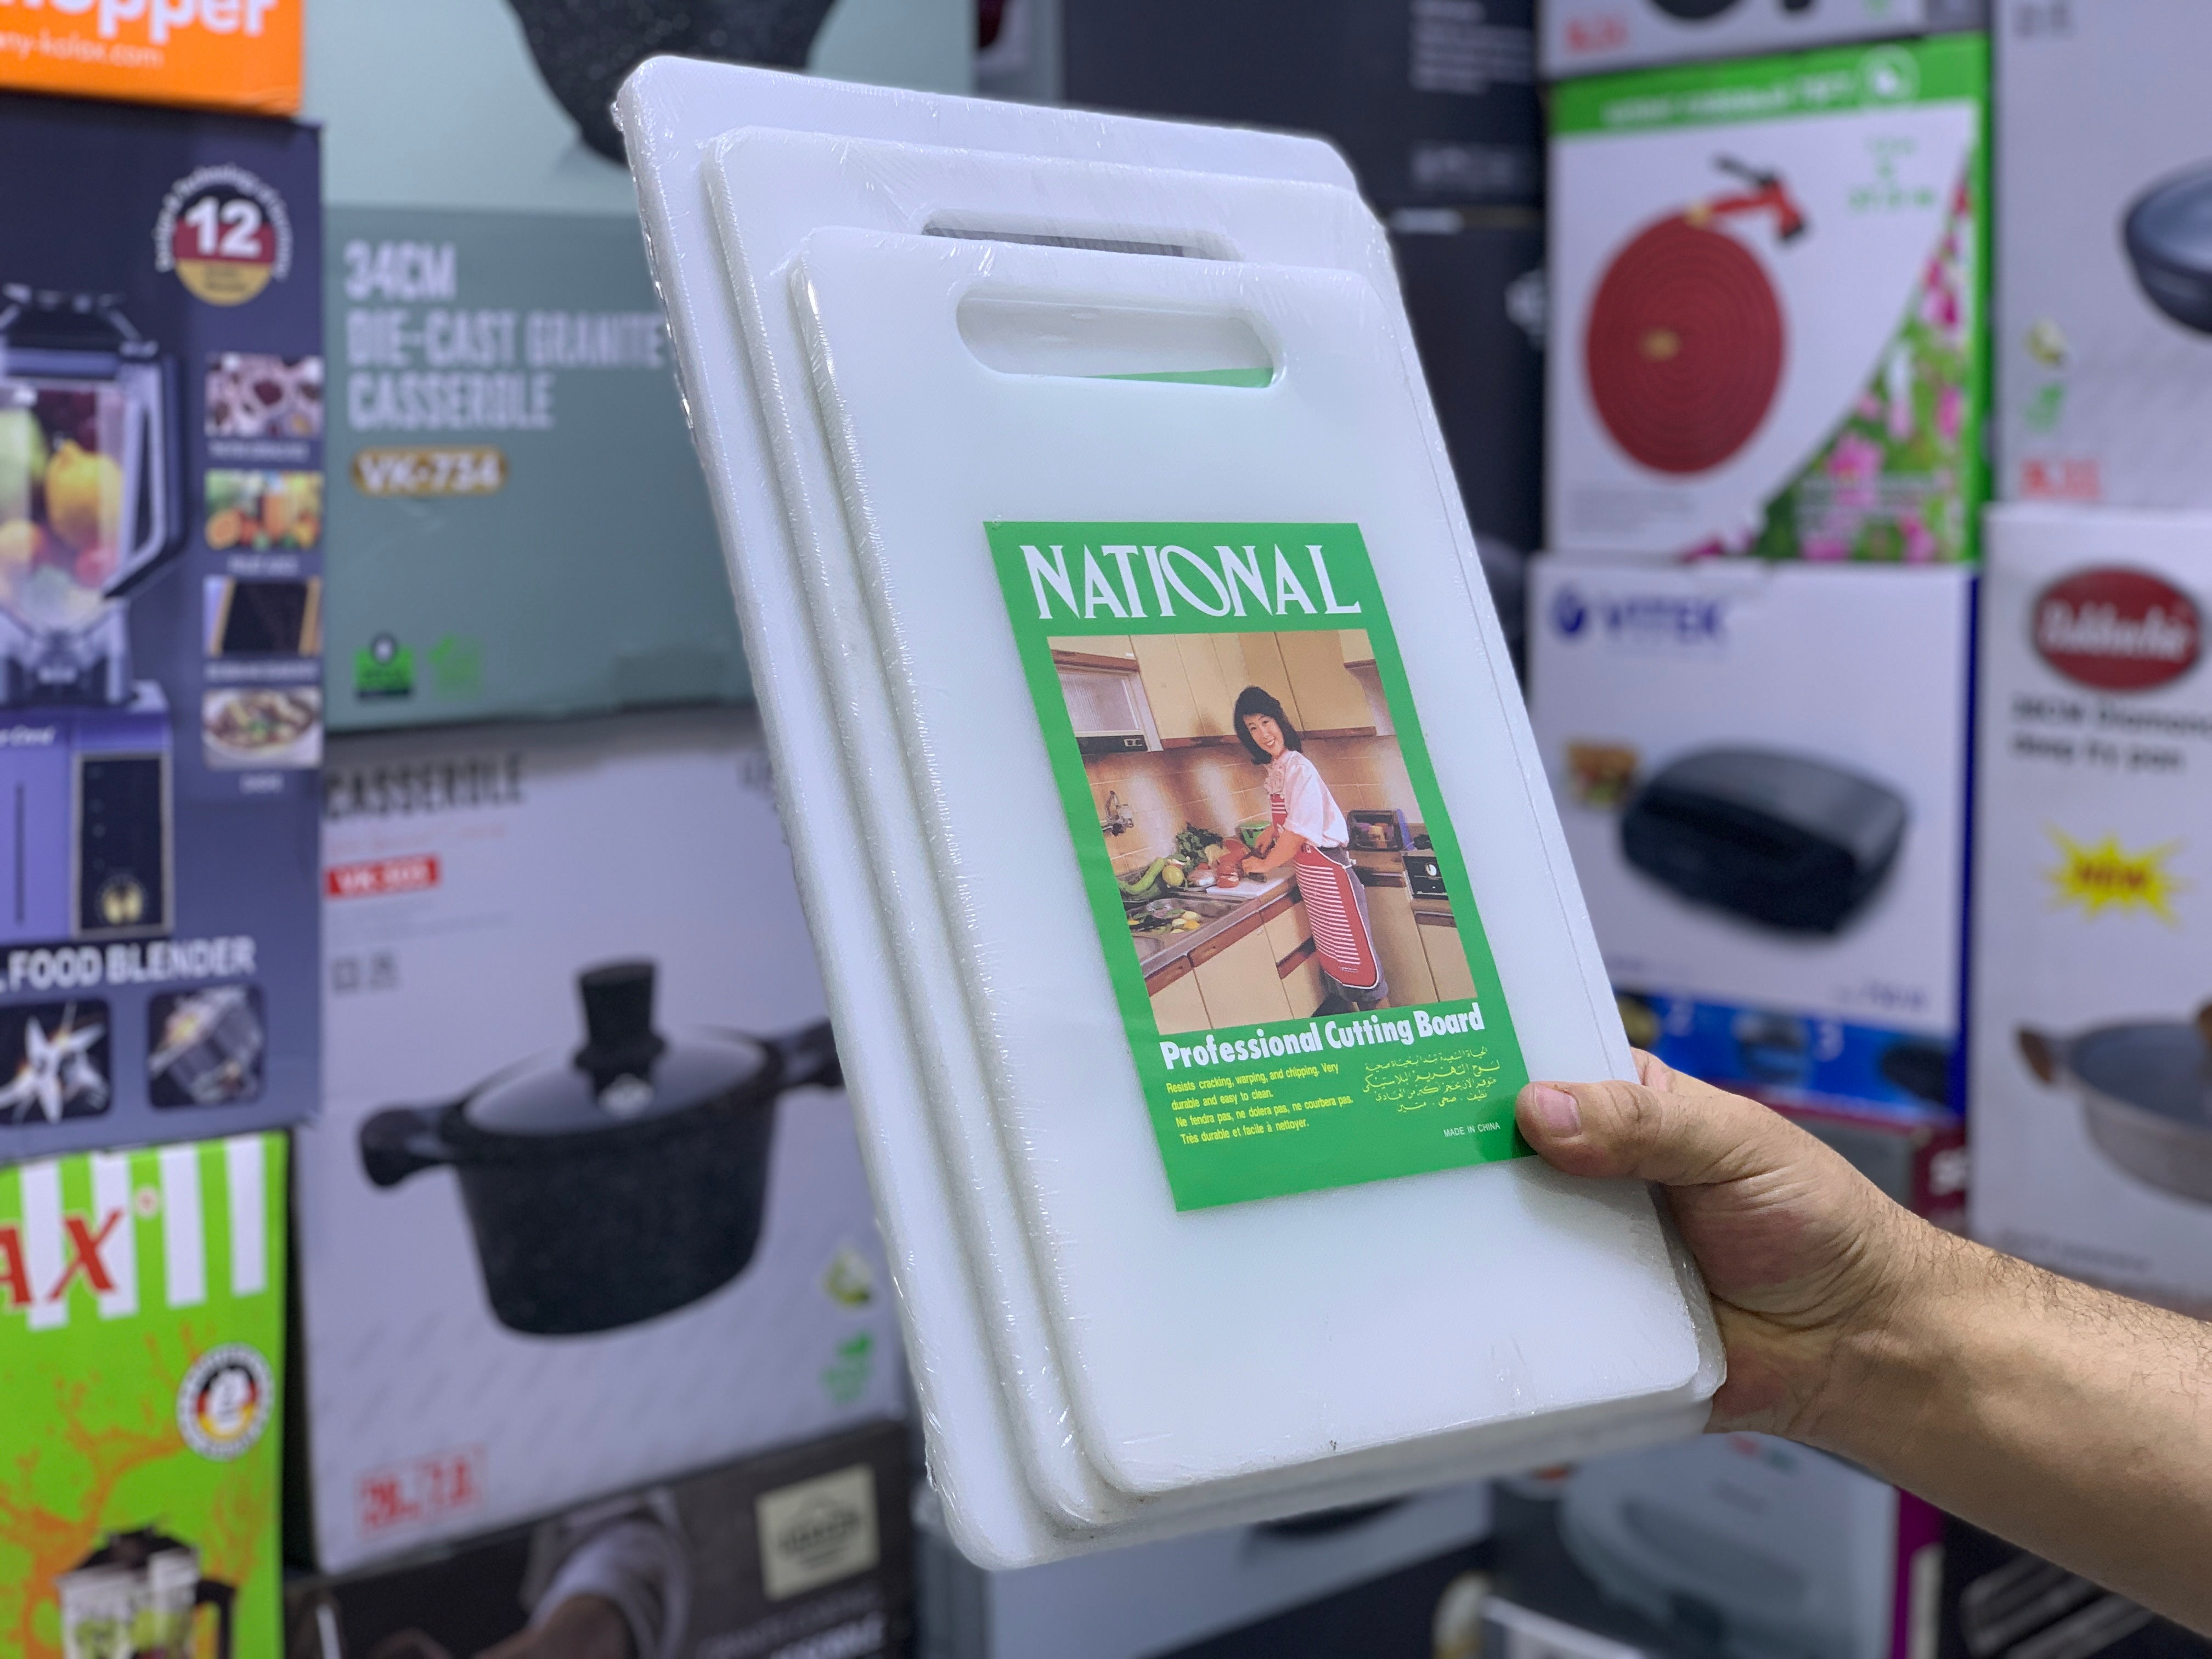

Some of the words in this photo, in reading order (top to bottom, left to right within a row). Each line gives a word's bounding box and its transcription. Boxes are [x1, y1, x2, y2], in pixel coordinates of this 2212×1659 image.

[184, 196, 263, 258] 12
[343, 239, 457, 302] 34CM
[345, 308, 517, 369] DIE-CAST
[523, 311, 666, 370] GRANITE
[346, 371, 556, 431] CASSEROLE
[1019, 544, 1362, 619] NATIONAL
[8, 946, 103, 991] FOOD
[106, 936, 258, 985] BLENDER
[1159, 1022, 1324, 1070] Professional
[1324, 1014, 1415, 1049] Cutting
[1413, 1002, 1485, 1038] Board
[1166, 1081, 1196, 1093] Resists
[1199, 1076, 1234, 1088] cracking,
[1235, 1073, 1268, 1085] warping,
[1269, 1068, 1284, 1080] and
[1285, 1065, 1320, 1079] chipping.
[1321, 1063, 1339, 1074] Very
[1171, 1097, 1200, 1110] durable
[1203, 1094, 1218, 1106] and
[1220, 1094, 1238, 1105] easy
[1240, 1091, 1249, 1101] to
[1251, 1089, 1273, 1099] clean.
[1176, 1117, 1188, 1127] Ne
[1189, 1113, 1215, 1125] fendra
[1217, 1112, 1234, 1125] pas,
[1235, 1110, 1246, 1119] ne
[1273, 1104, 1290, 1116] pas,
[1292, 1102, 1302, 1111] ne
[1304, 1098, 1336, 1109] courbera
[1338, 1096, 1353, 1108] pas.
[1180, 1133, 1199, 1144] Très
[1201, 1128, 1230, 1142] durable
[1232, 1127, 1241, 1137] et
[1243, 1123, 1264, 1136] facile
[1267, 1121, 1273, 1132] à
[1276, 1119, 1310, 1131] nettoyer.
[1443, 1126, 1465, 1137] MADE
[1467, 1125, 1476, 1134] IN
[1477, 1122, 1501, 1132] CHINA
